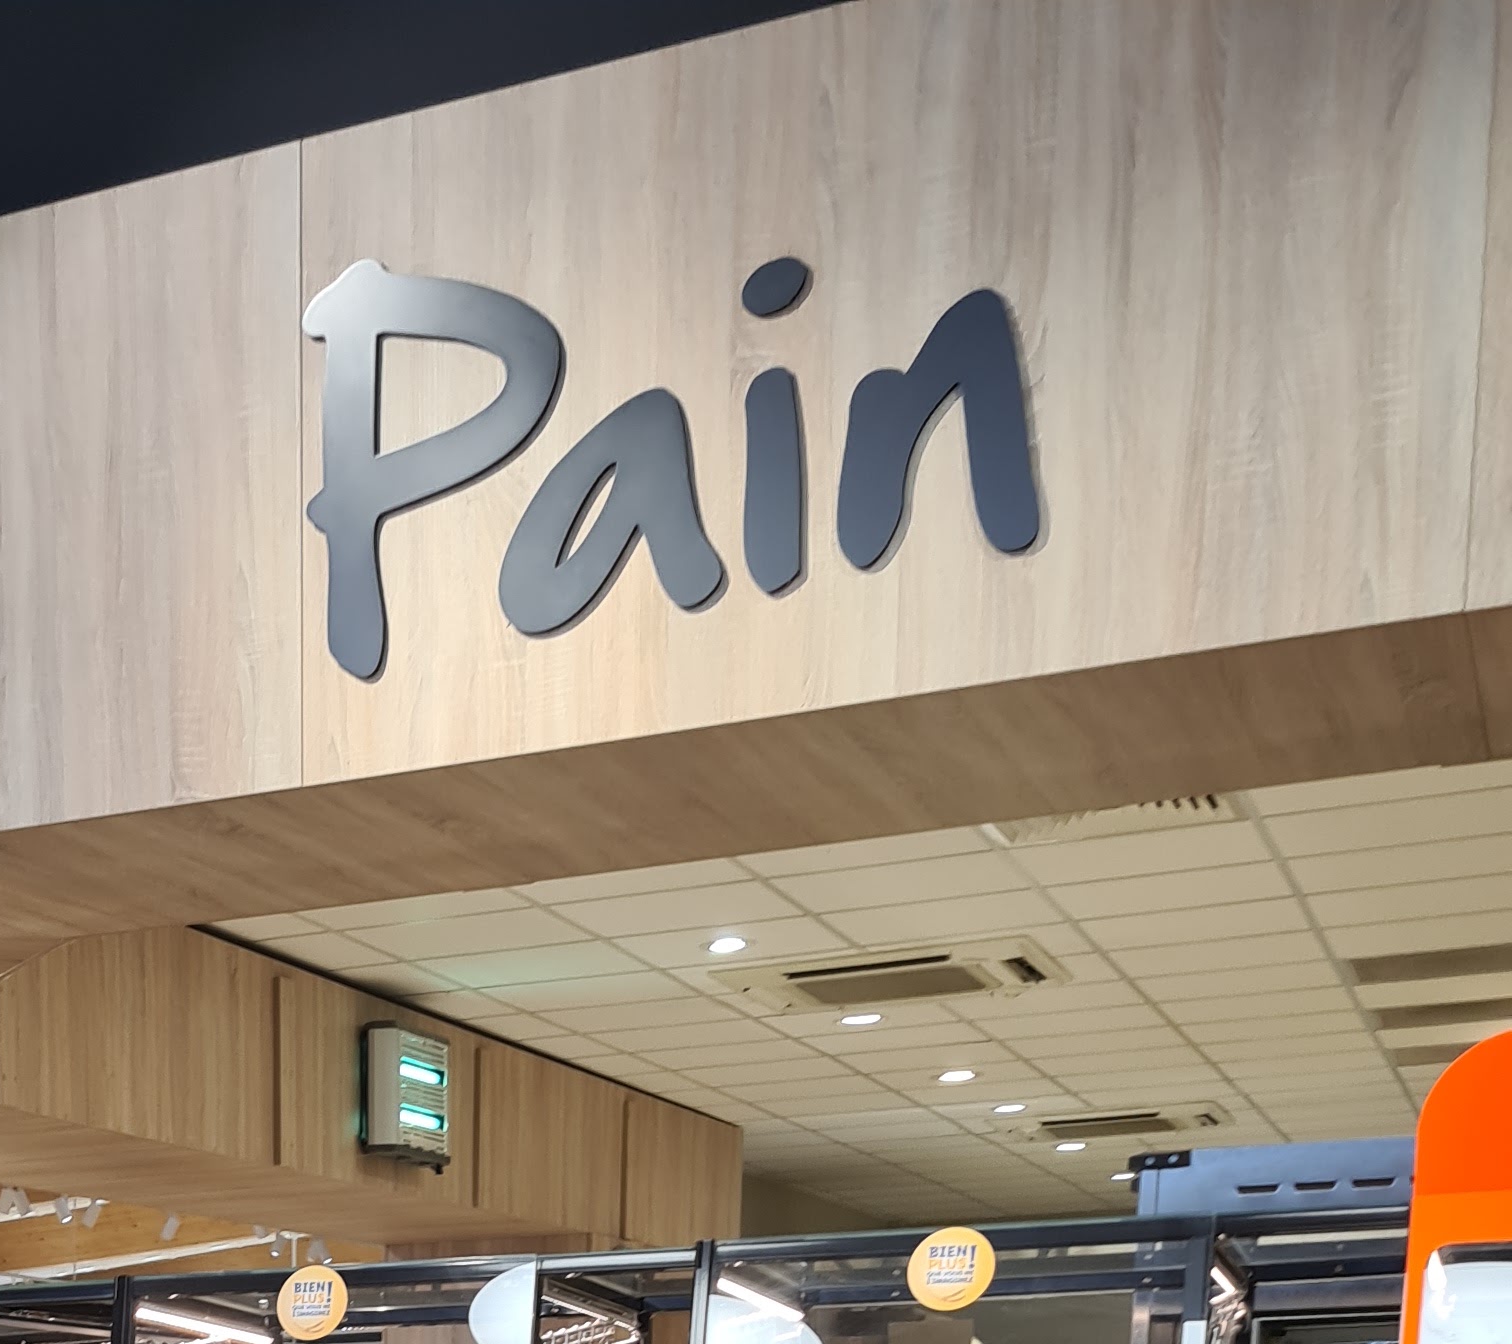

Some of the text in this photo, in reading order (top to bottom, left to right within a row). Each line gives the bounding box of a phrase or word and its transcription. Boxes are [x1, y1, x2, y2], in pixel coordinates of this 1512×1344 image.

[301, 256, 1041, 682] Pain
[928, 1245, 968, 1259] BIEN
[294, 1281, 326, 1294] BIEN
